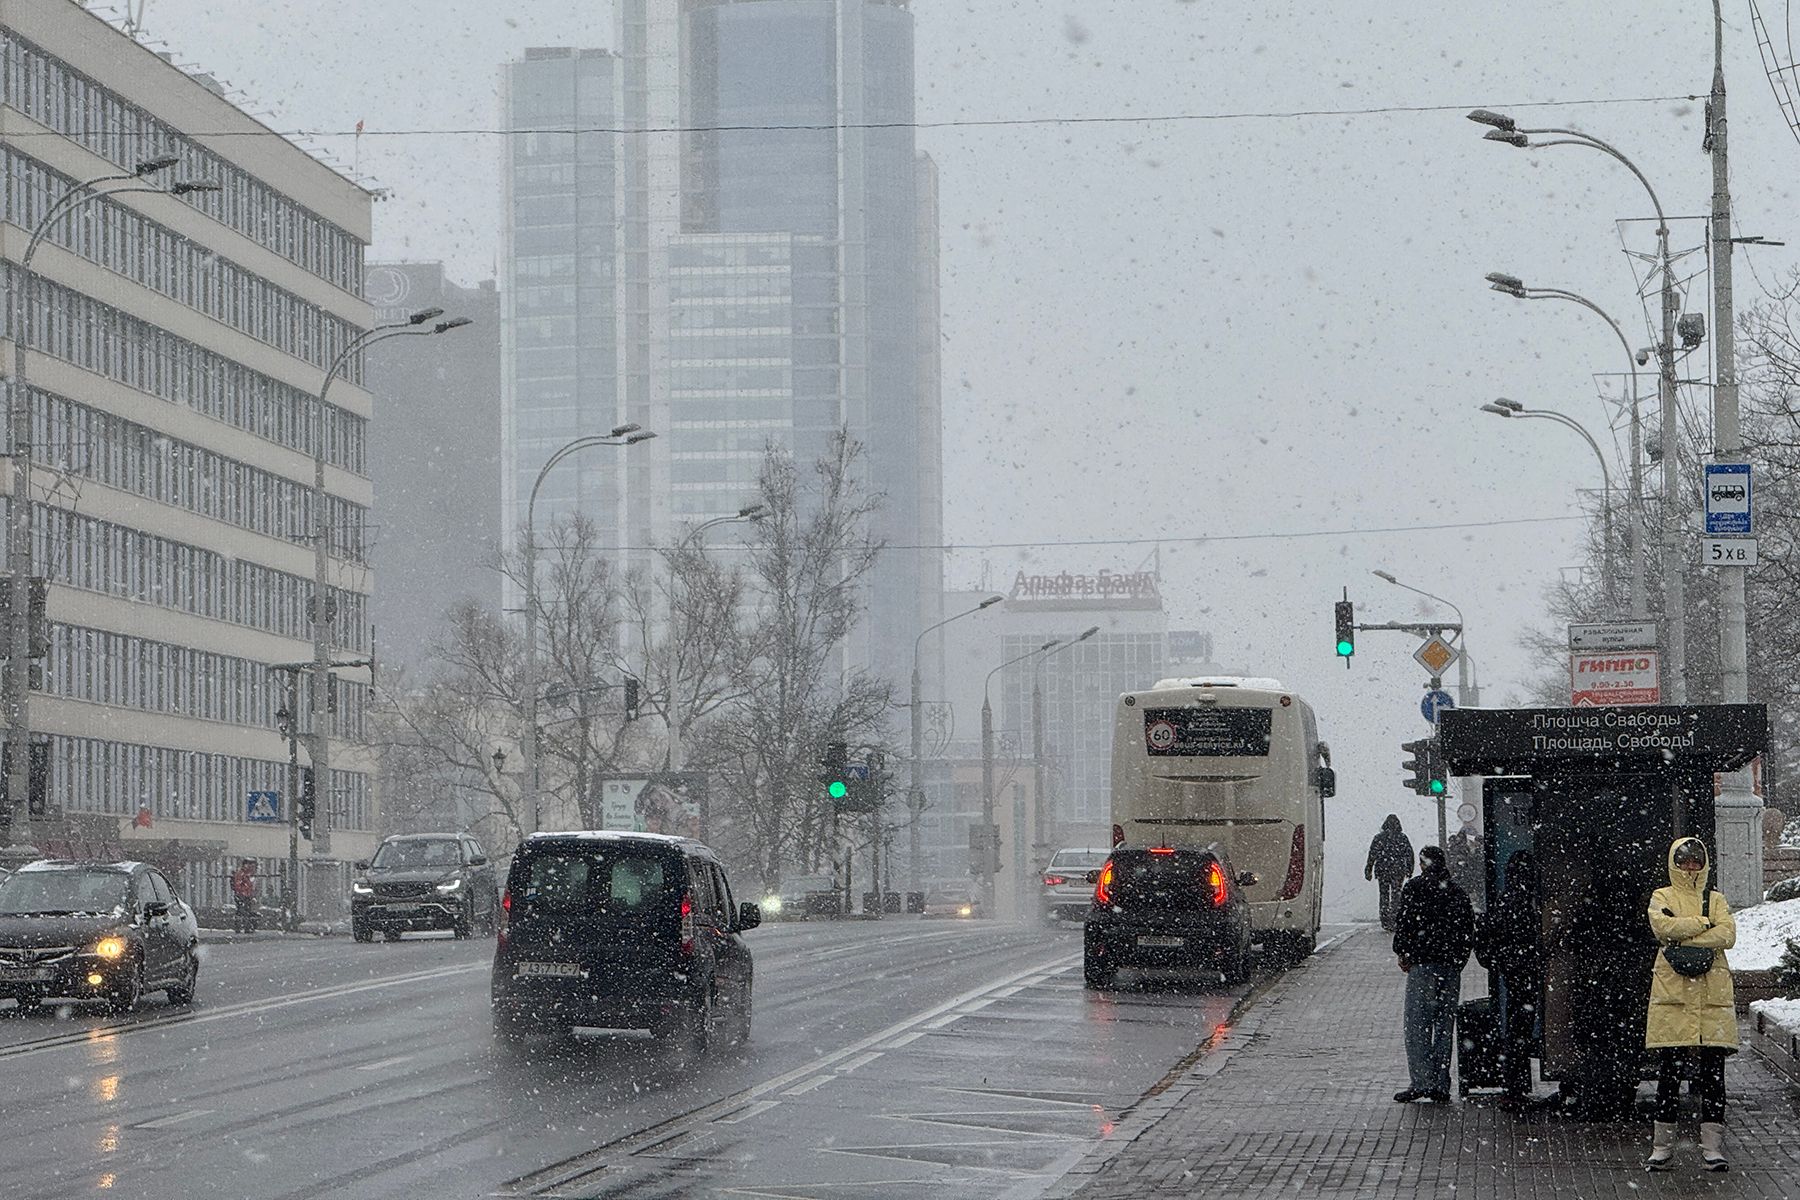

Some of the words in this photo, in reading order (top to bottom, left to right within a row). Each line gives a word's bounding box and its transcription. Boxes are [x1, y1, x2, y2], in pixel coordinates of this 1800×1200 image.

[1712, 544, 1722, 560] 5
[1532, 713, 1600, 729] Плошча
[1604, 711, 1681, 728] Свабоды
[1153, 729, 1170, 741] 60
[1532, 735, 1613, 750] Площадь
[1616, 732, 1695, 749] Свободы
